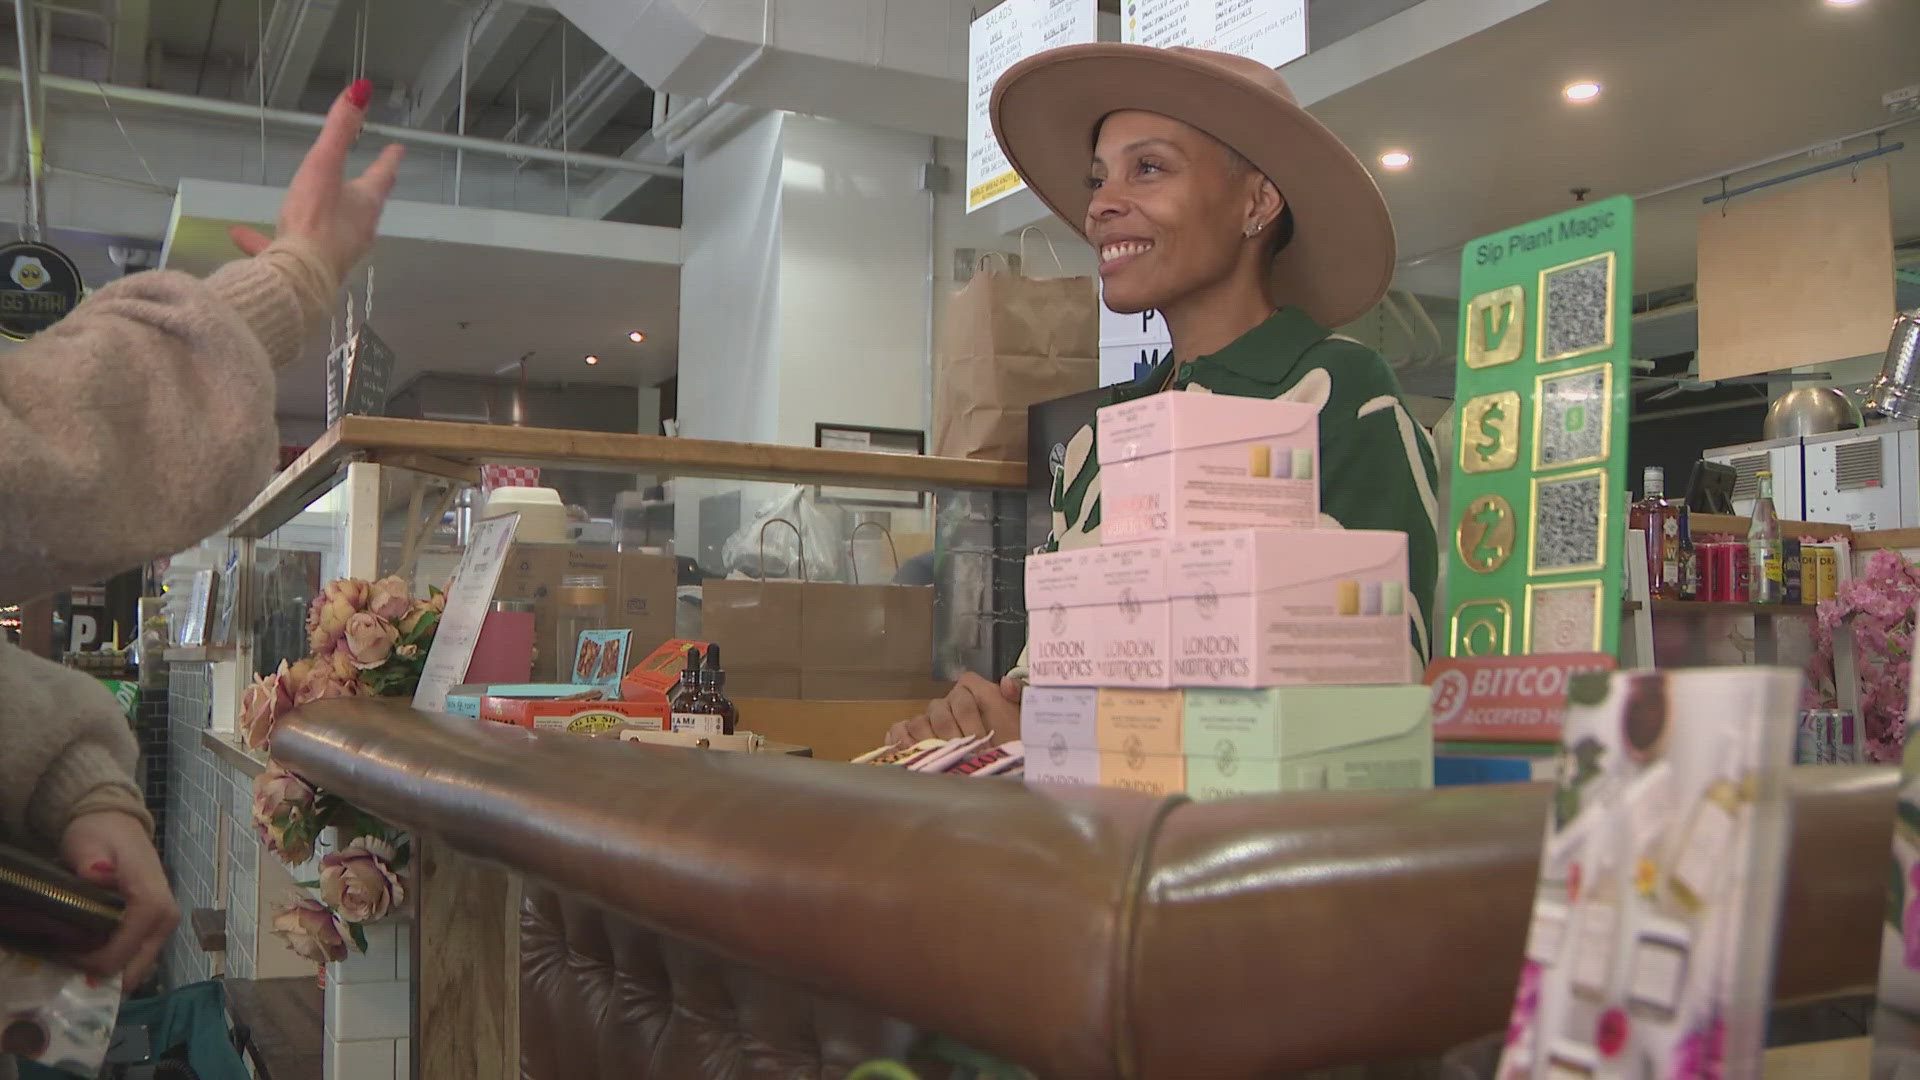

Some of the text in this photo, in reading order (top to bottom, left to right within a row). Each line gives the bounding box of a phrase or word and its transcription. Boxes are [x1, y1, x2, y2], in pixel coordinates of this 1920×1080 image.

[985, 4, 1013, 30] SALADS
[1476, 210, 1615, 266] Sip Plant Magic
[1038, 641, 1085, 659] LONDON
[1105, 640, 1155, 659] LONDON
[1182, 635, 1240, 656] LONDON
[1470, 665, 1602, 697] BITCOI
[1462, 707, 1545, 726] ACCEPTED
